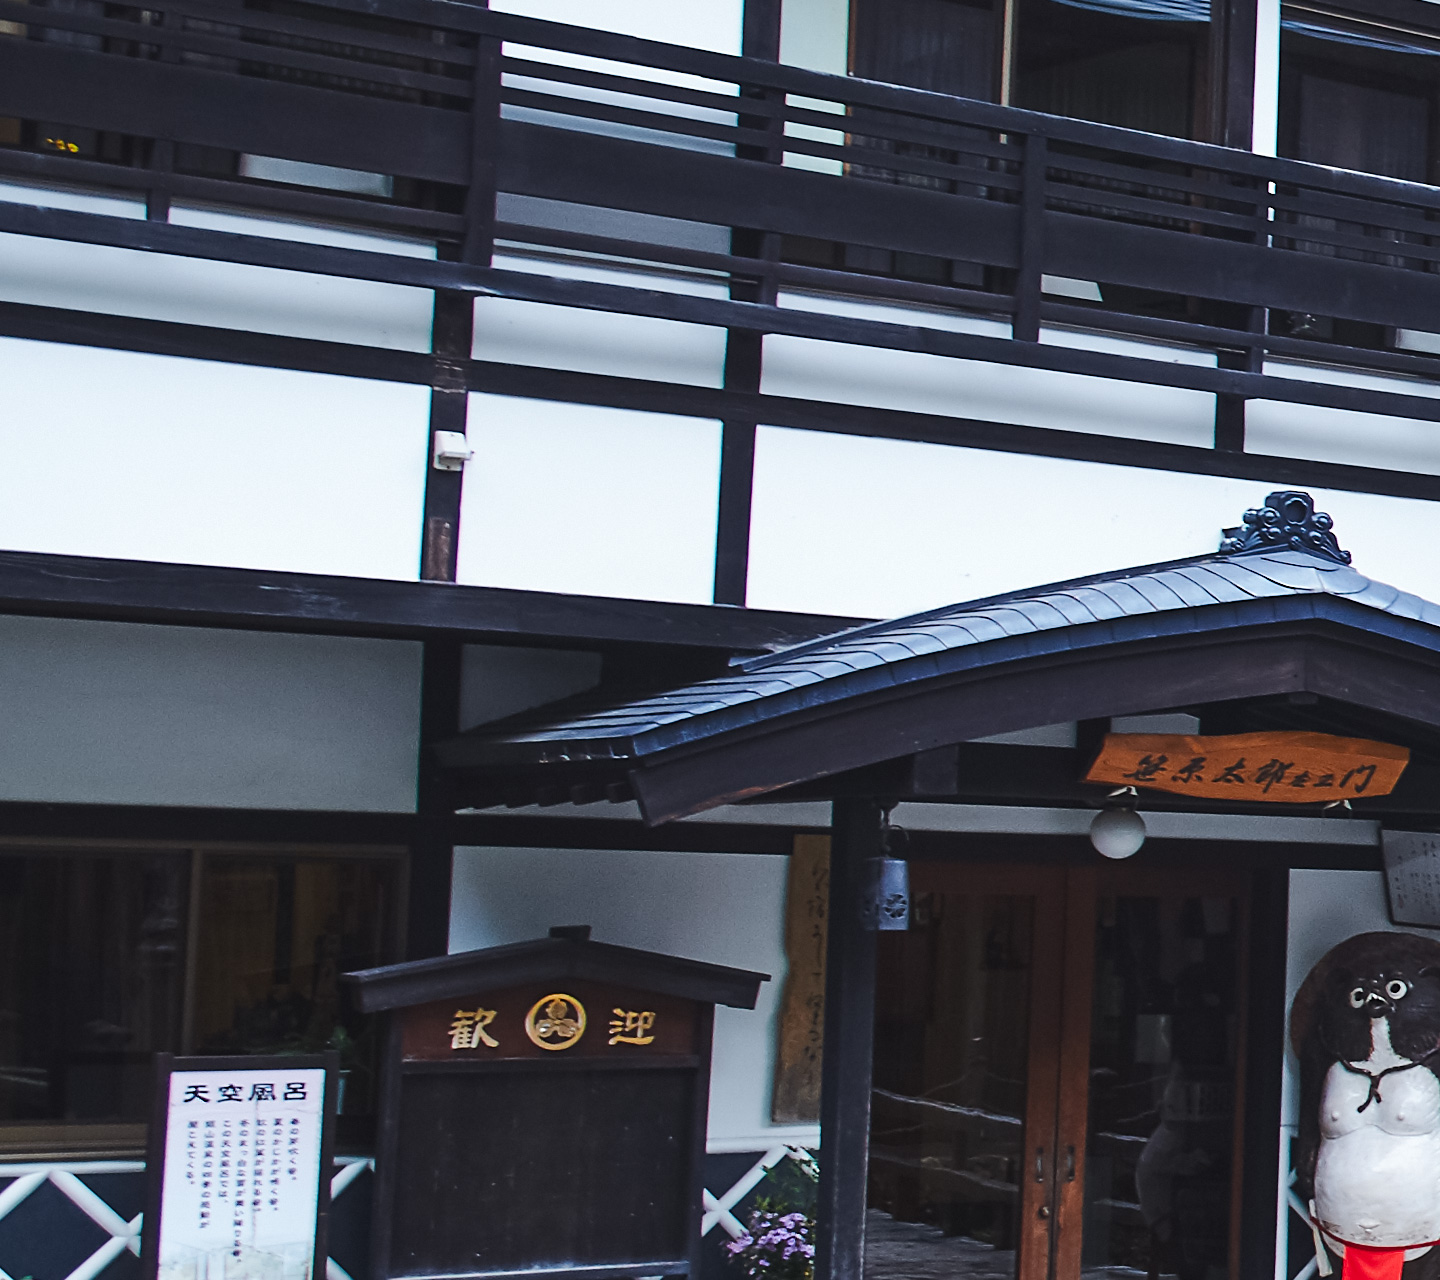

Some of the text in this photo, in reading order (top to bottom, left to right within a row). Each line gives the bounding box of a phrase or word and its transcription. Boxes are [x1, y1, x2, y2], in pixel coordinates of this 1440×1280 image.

[448, 1007, 656, 1050] 歓迎
[183, 1082, 307, 1103] 天空風呂
